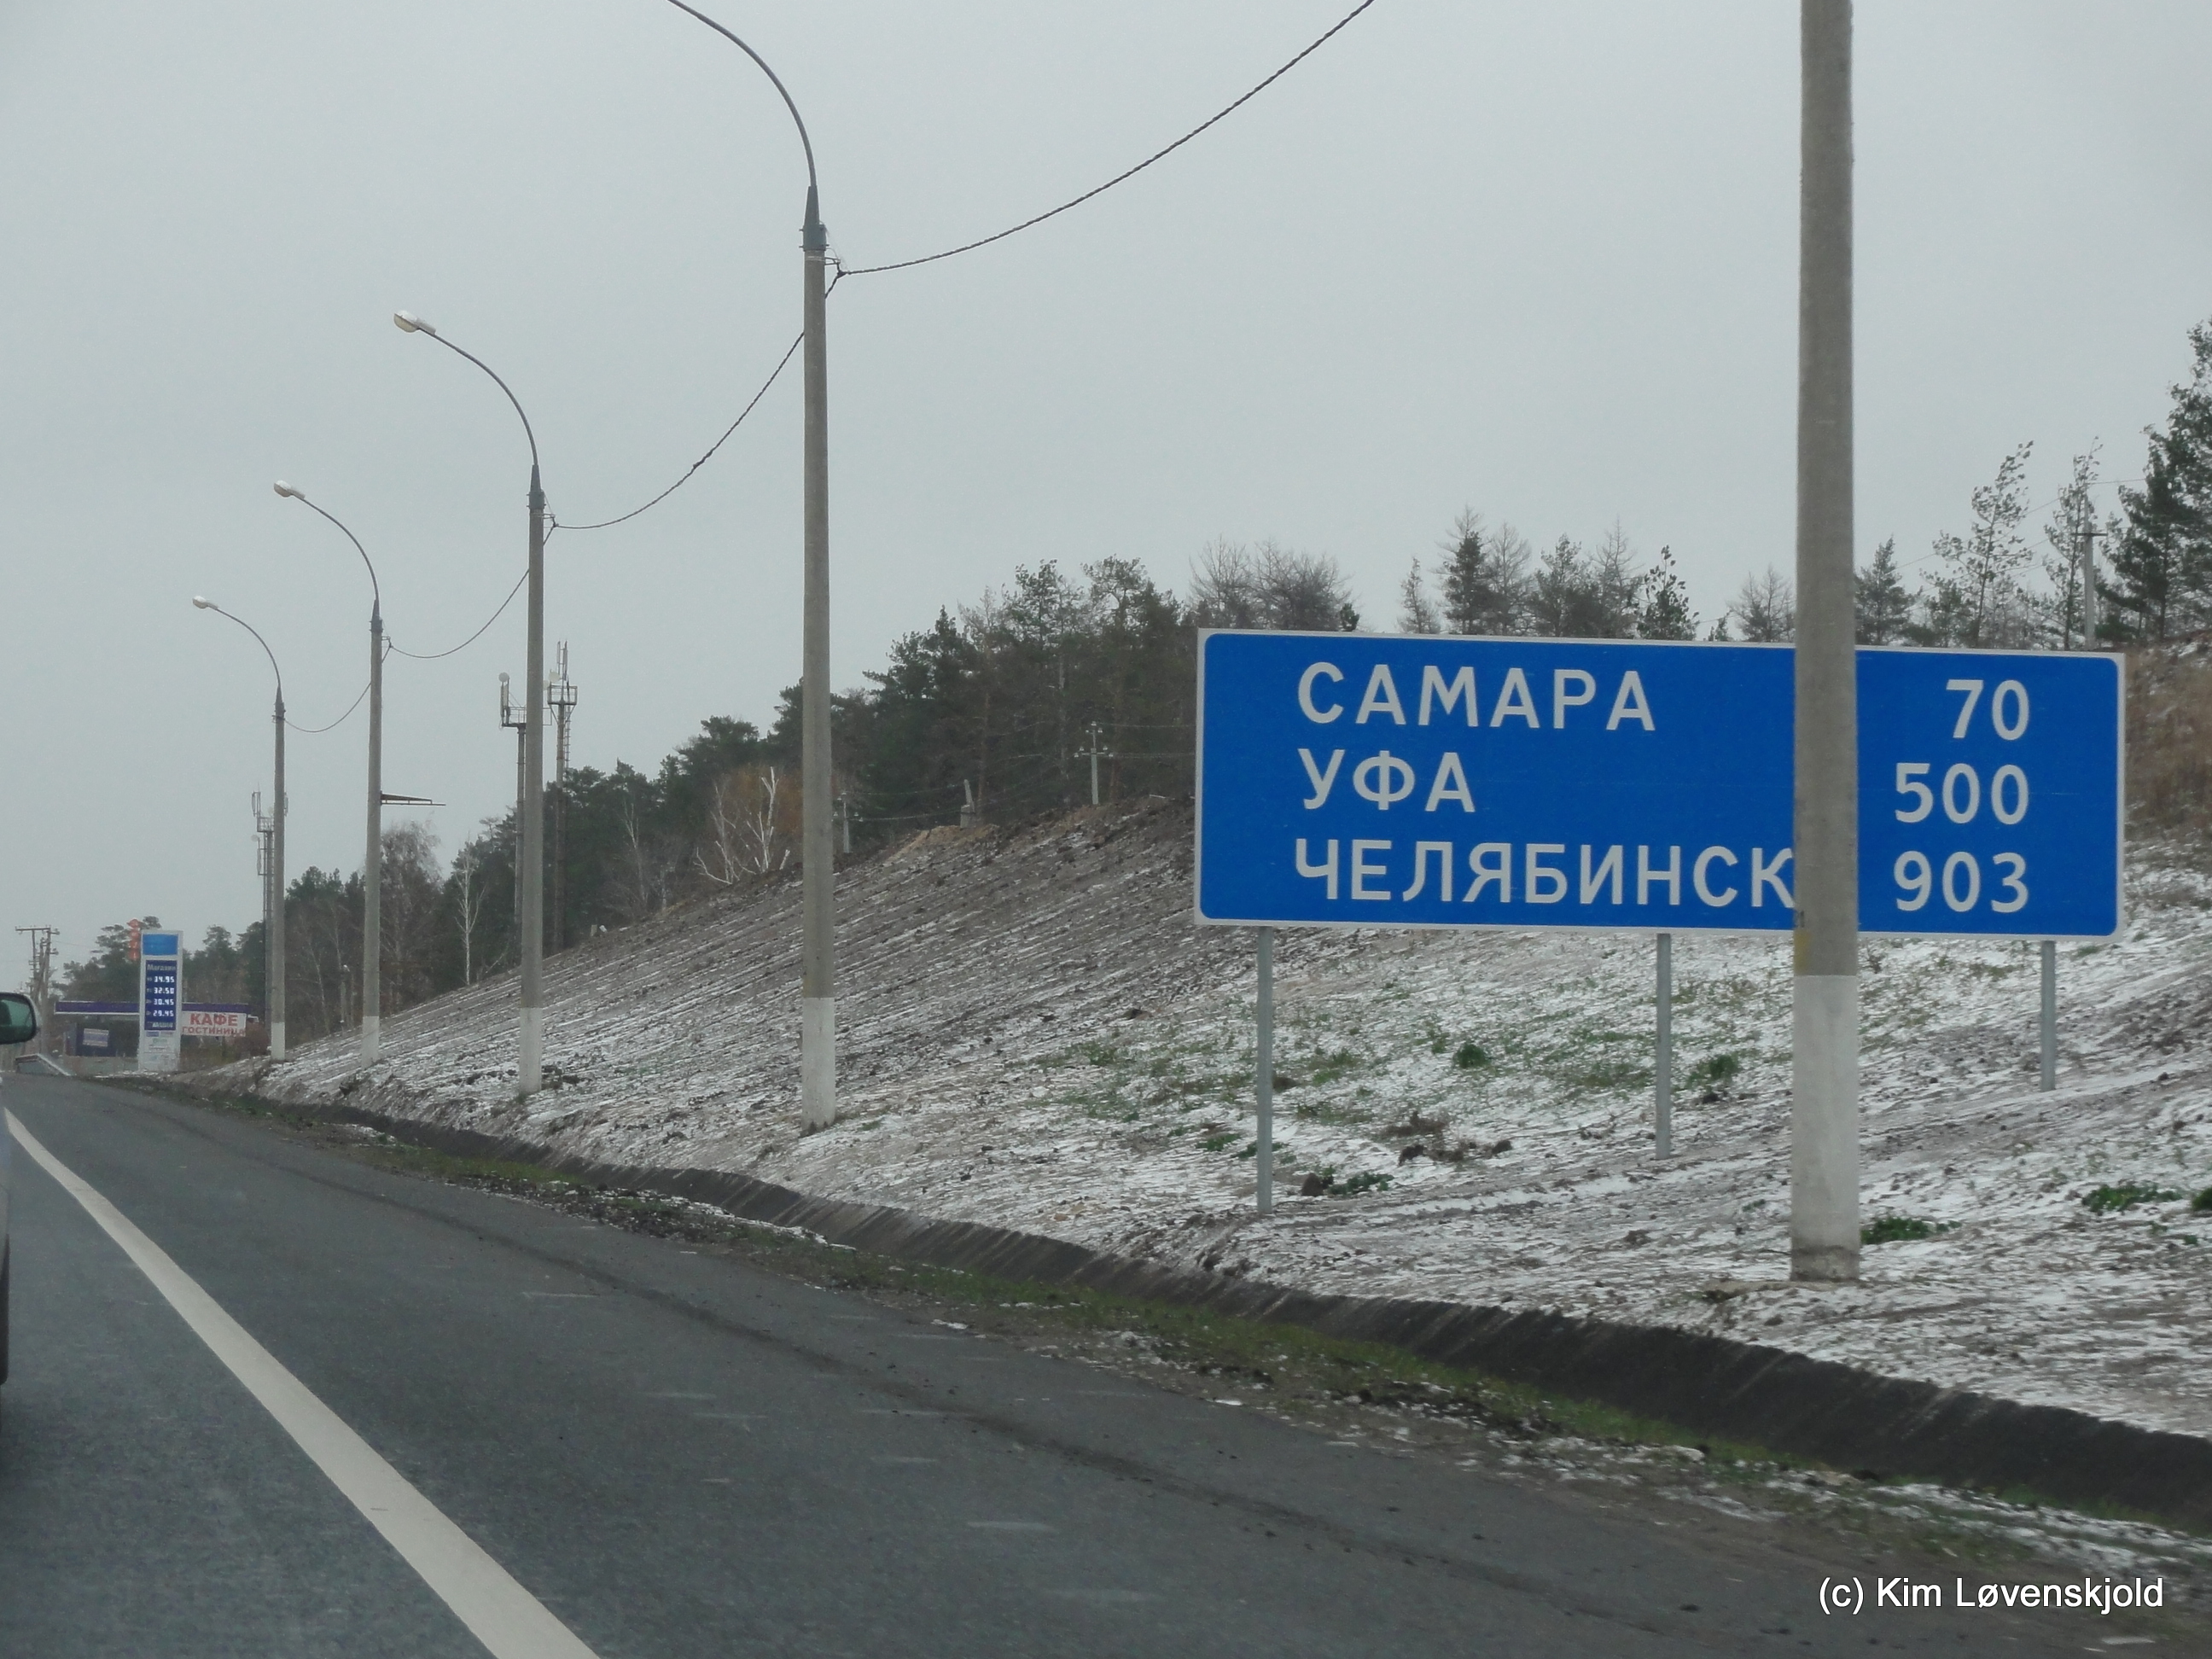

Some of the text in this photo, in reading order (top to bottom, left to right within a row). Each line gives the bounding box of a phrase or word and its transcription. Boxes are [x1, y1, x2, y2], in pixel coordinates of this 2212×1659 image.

[1298, 661, 2029, 741] САМАРА 70
[1298, 748, 2029, 825] УФА 500
[1295, 838, 2029, 913] ЧЕЛЯБИНСК 903
[182, 1026, 245, 1037] ГОСТИНИЦА
[190, 1013, 238, 1027] КАФЕ
